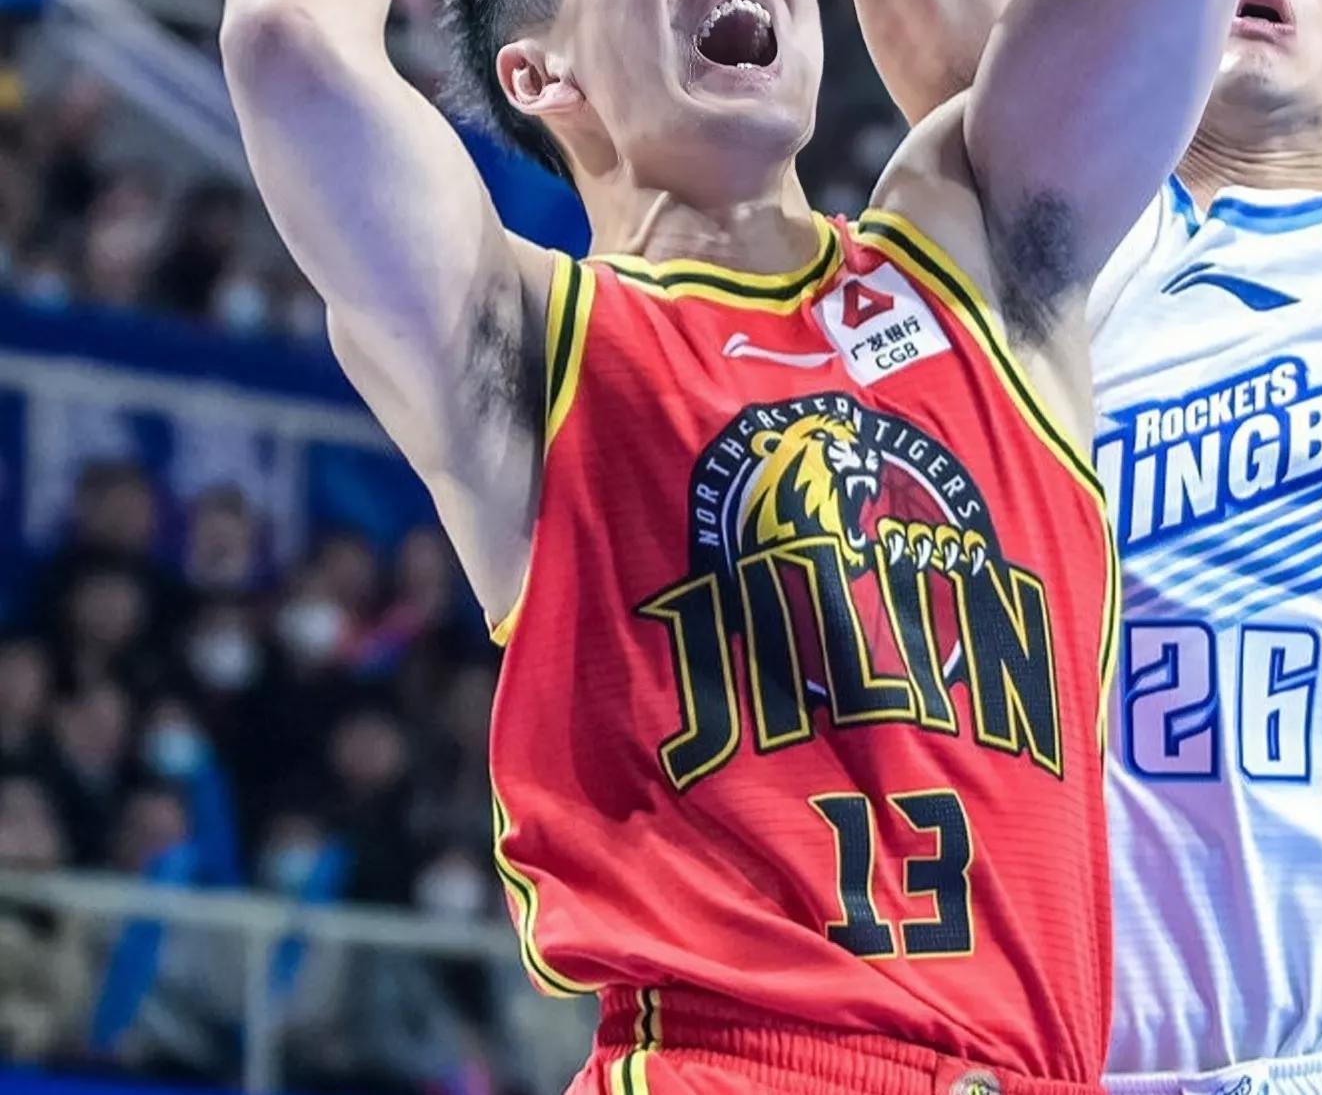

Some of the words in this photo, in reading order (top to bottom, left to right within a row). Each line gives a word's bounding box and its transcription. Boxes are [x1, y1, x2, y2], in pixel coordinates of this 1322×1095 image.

[875, 342, 919, 370] CGB
[1133, 362, 1299, 455] ROCKETS
[874, 418, 981, 519] TIGERS
[638, 535, 1063, 791] JILIN
[1124, 619, 1320, 783] 26
[808, 787, 973, 960] 13
